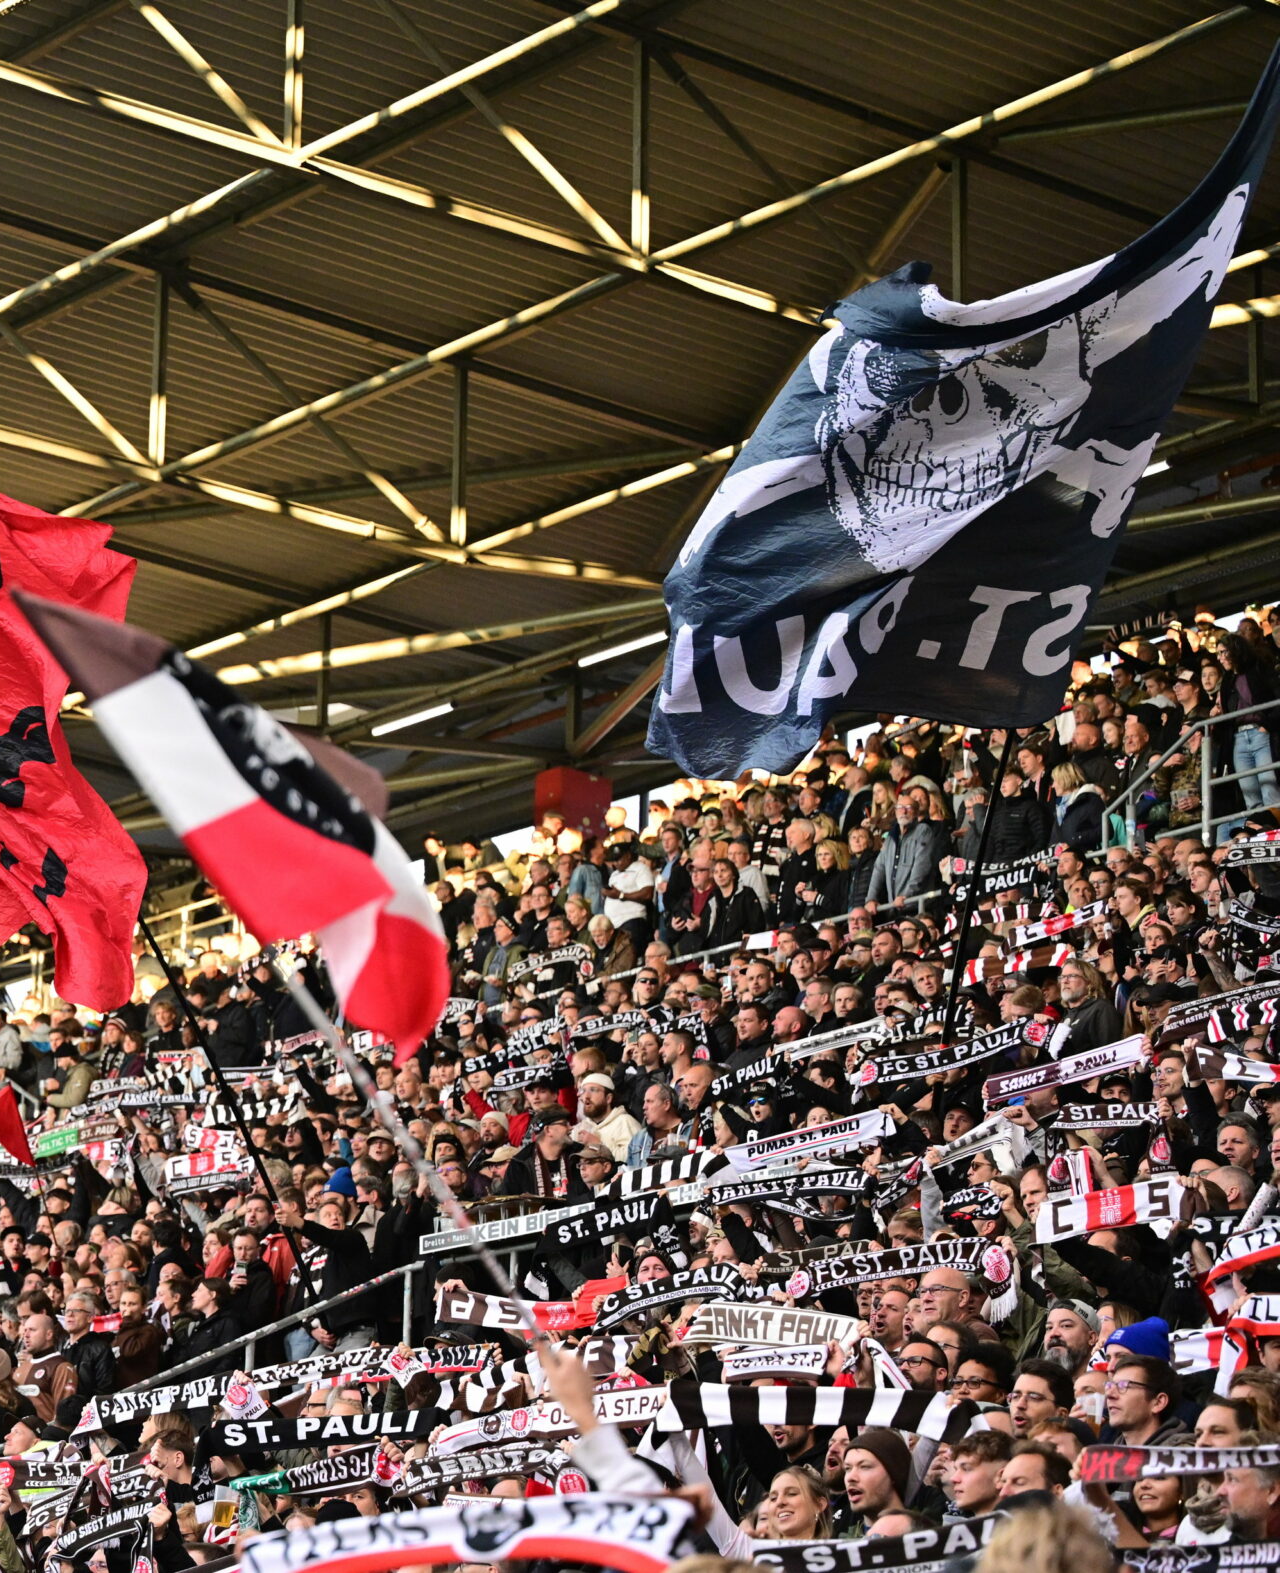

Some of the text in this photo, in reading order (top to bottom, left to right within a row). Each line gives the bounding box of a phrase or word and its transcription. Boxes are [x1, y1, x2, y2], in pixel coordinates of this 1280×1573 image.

[985, 866, 1036, 893] PAULI
[586, 1016, 609, 1030] ST.
[465, 1053, 493, 1073] ST.
[882, 1025, 1022, 1076] FC ST. PAULI
[494, 1073, 521, 1086] ST.
[711, 1055, 781, 1096] ST. PAULI
[1070, 1105, 1102, 1121] ST.
[747, 1118, 860, 1158] PUMAS ST. PAULI
[711, 1178, 782, 1203] SANKT
[802, 1170, 866, 1189] PAULI
[475, 1223, 521, 1242] KEIN
[556, 1197, 659, 1244] ST. PAULI
[422, 1236, 446, 1249] Breite
[814, 1241, 977, 1284] FC ST. PAULI
[617, 1289, 687, 1317] MILLERNTOR-STADION
[625, 1279, 665, 1300] ST.
[690, 1306, 855, 1344] SANKT PAULI
[427, 1344, 482, 1368] PAULI
[100, 1376, 228, 1418] SANKT PAULI
[224, 1410, 420, 1447] ST. PAULI
[27, 1461, 47, 1477] FC
[53, 1462, 77, 1478] ST.
[350, 1452, 370, 1478] FC
[408, 1464, 524, 1493] HOME OF THE BRAVE
[23, 1511, 50, 1535] FC
[78, 1509, 122, 1538] SIEGT AM
[801, 1539, 884, 1573] ST.
